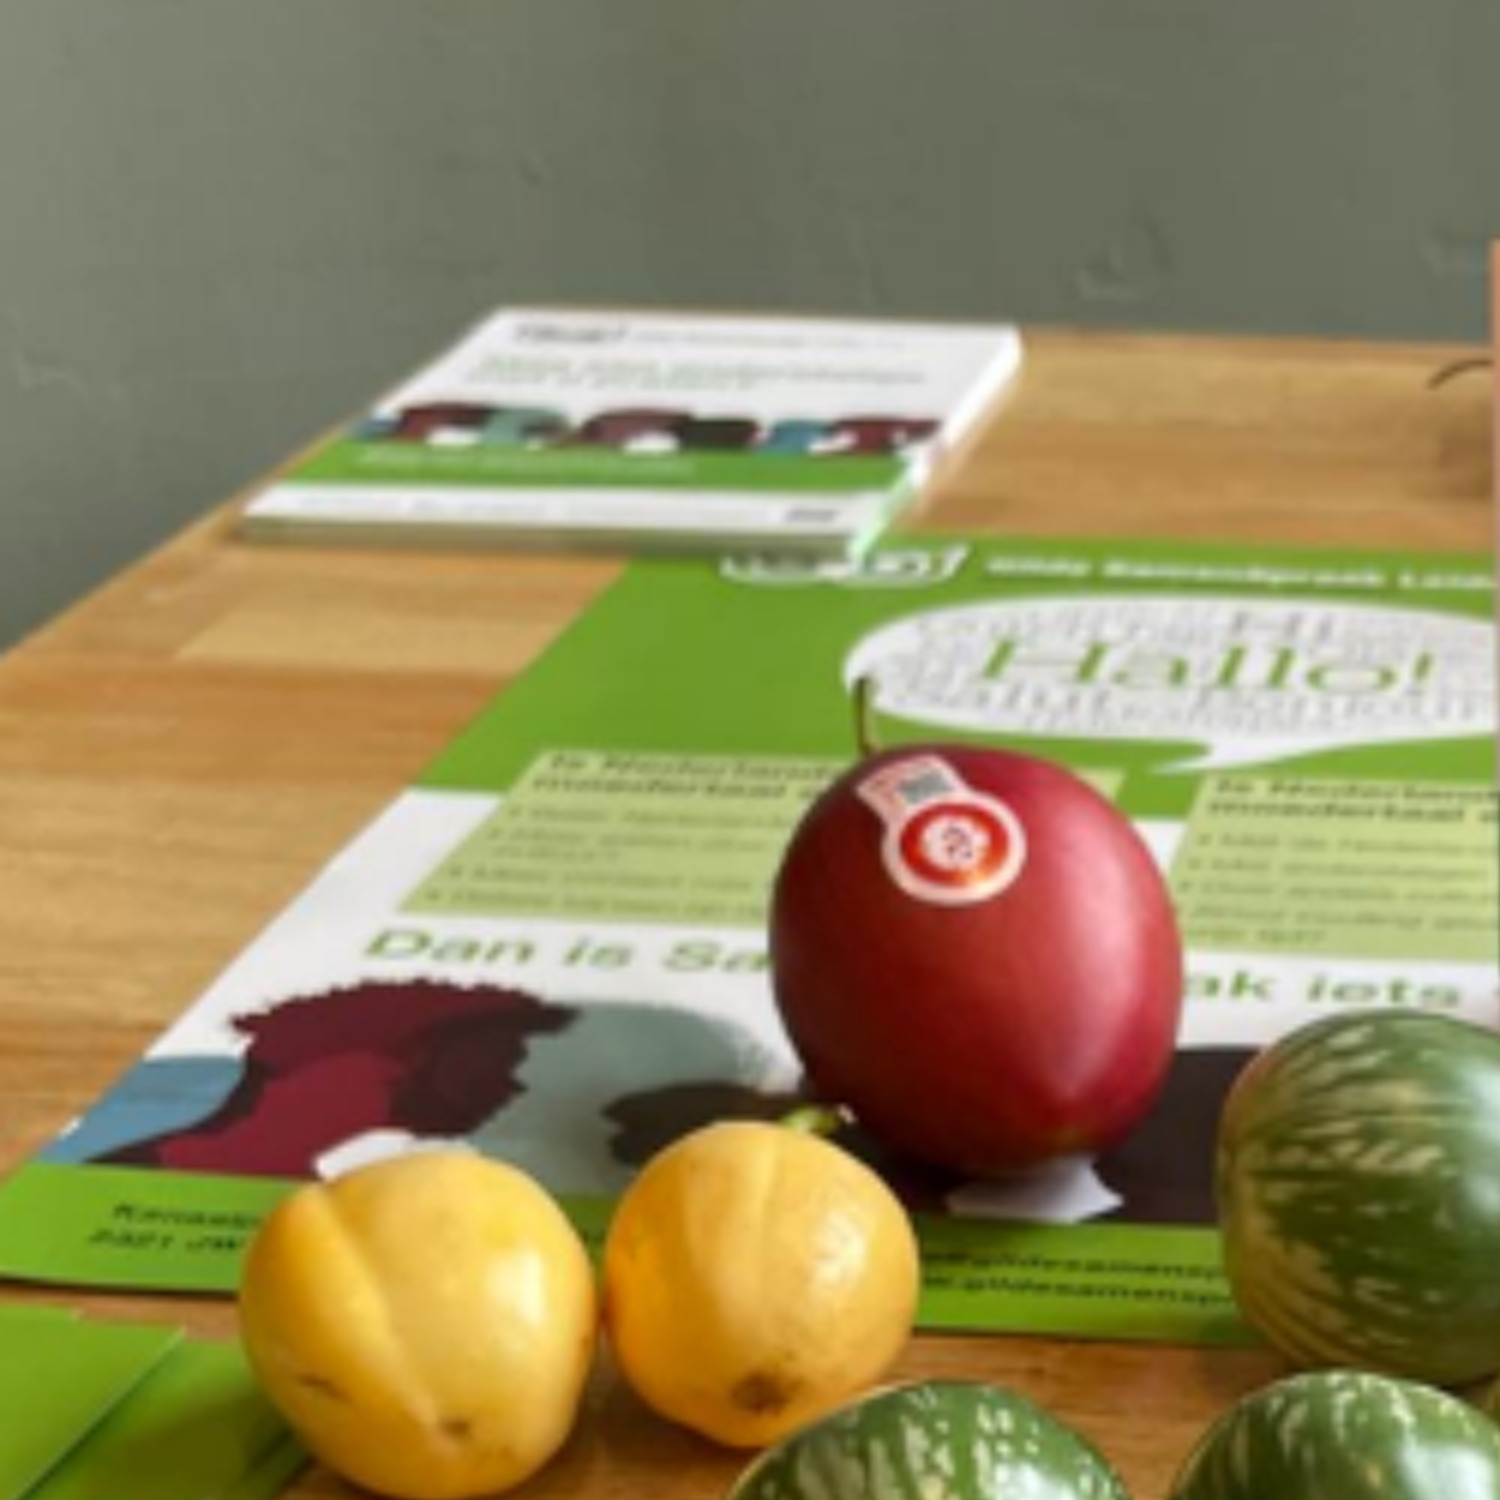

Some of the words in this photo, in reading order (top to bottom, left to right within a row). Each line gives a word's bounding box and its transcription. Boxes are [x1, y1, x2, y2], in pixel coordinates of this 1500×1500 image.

[984, 636, 1434, 696] Hallo!
[364, 928, 534, 969] Dan
[563, 934, 631, 970] is
[1305, 972, 1462, 1008] iets
